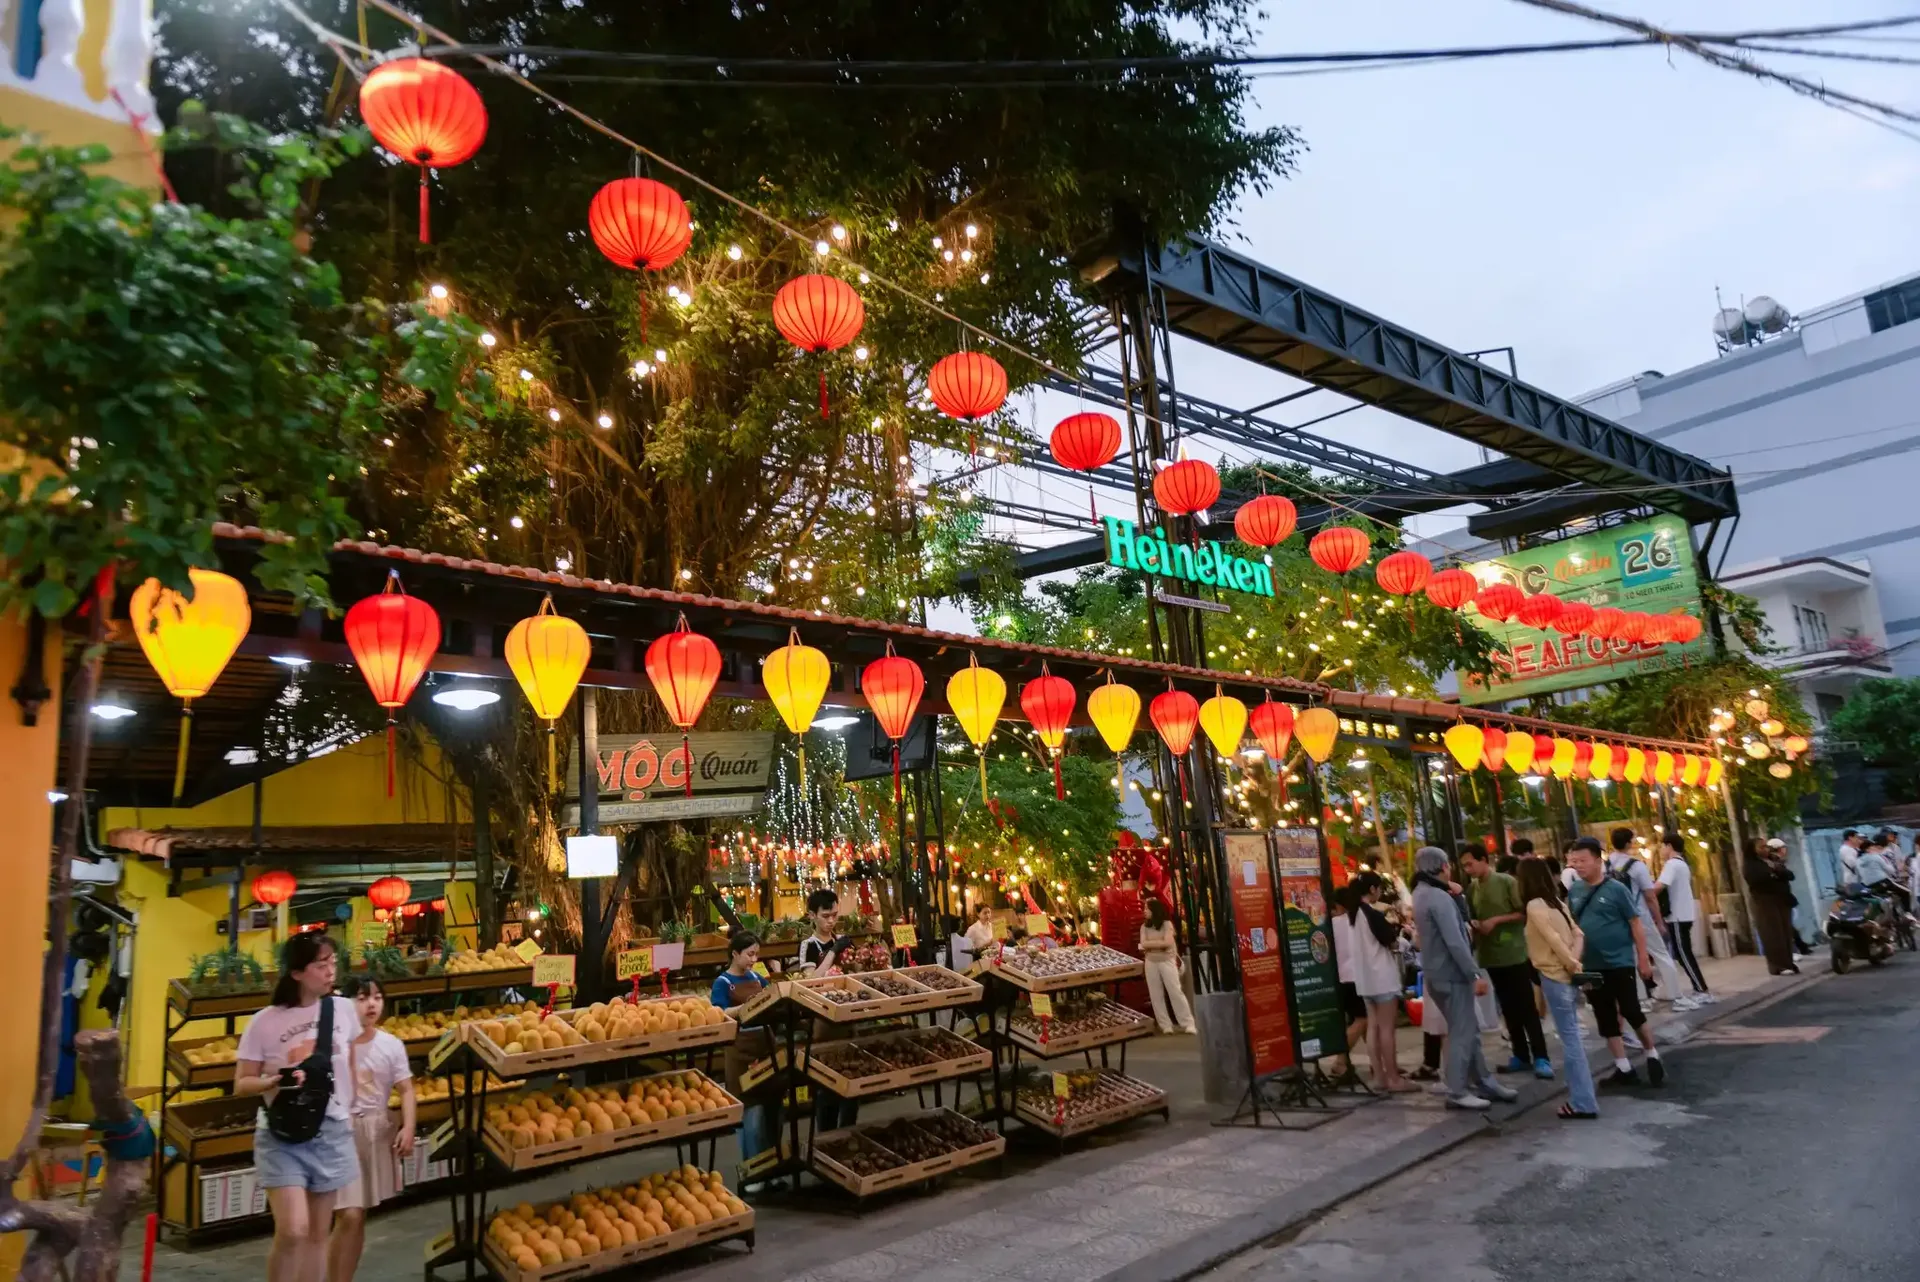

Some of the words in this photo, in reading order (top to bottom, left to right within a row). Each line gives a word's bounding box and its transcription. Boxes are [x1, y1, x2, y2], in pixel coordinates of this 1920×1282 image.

[1103, 515, 1275, 598] Heineken
[1621, 534, 1673, 576] 26
[597, 740, 695, 801] MỘC
[701, 751, 758, 782] Quán
[619, 952, 649, 965] Mango
